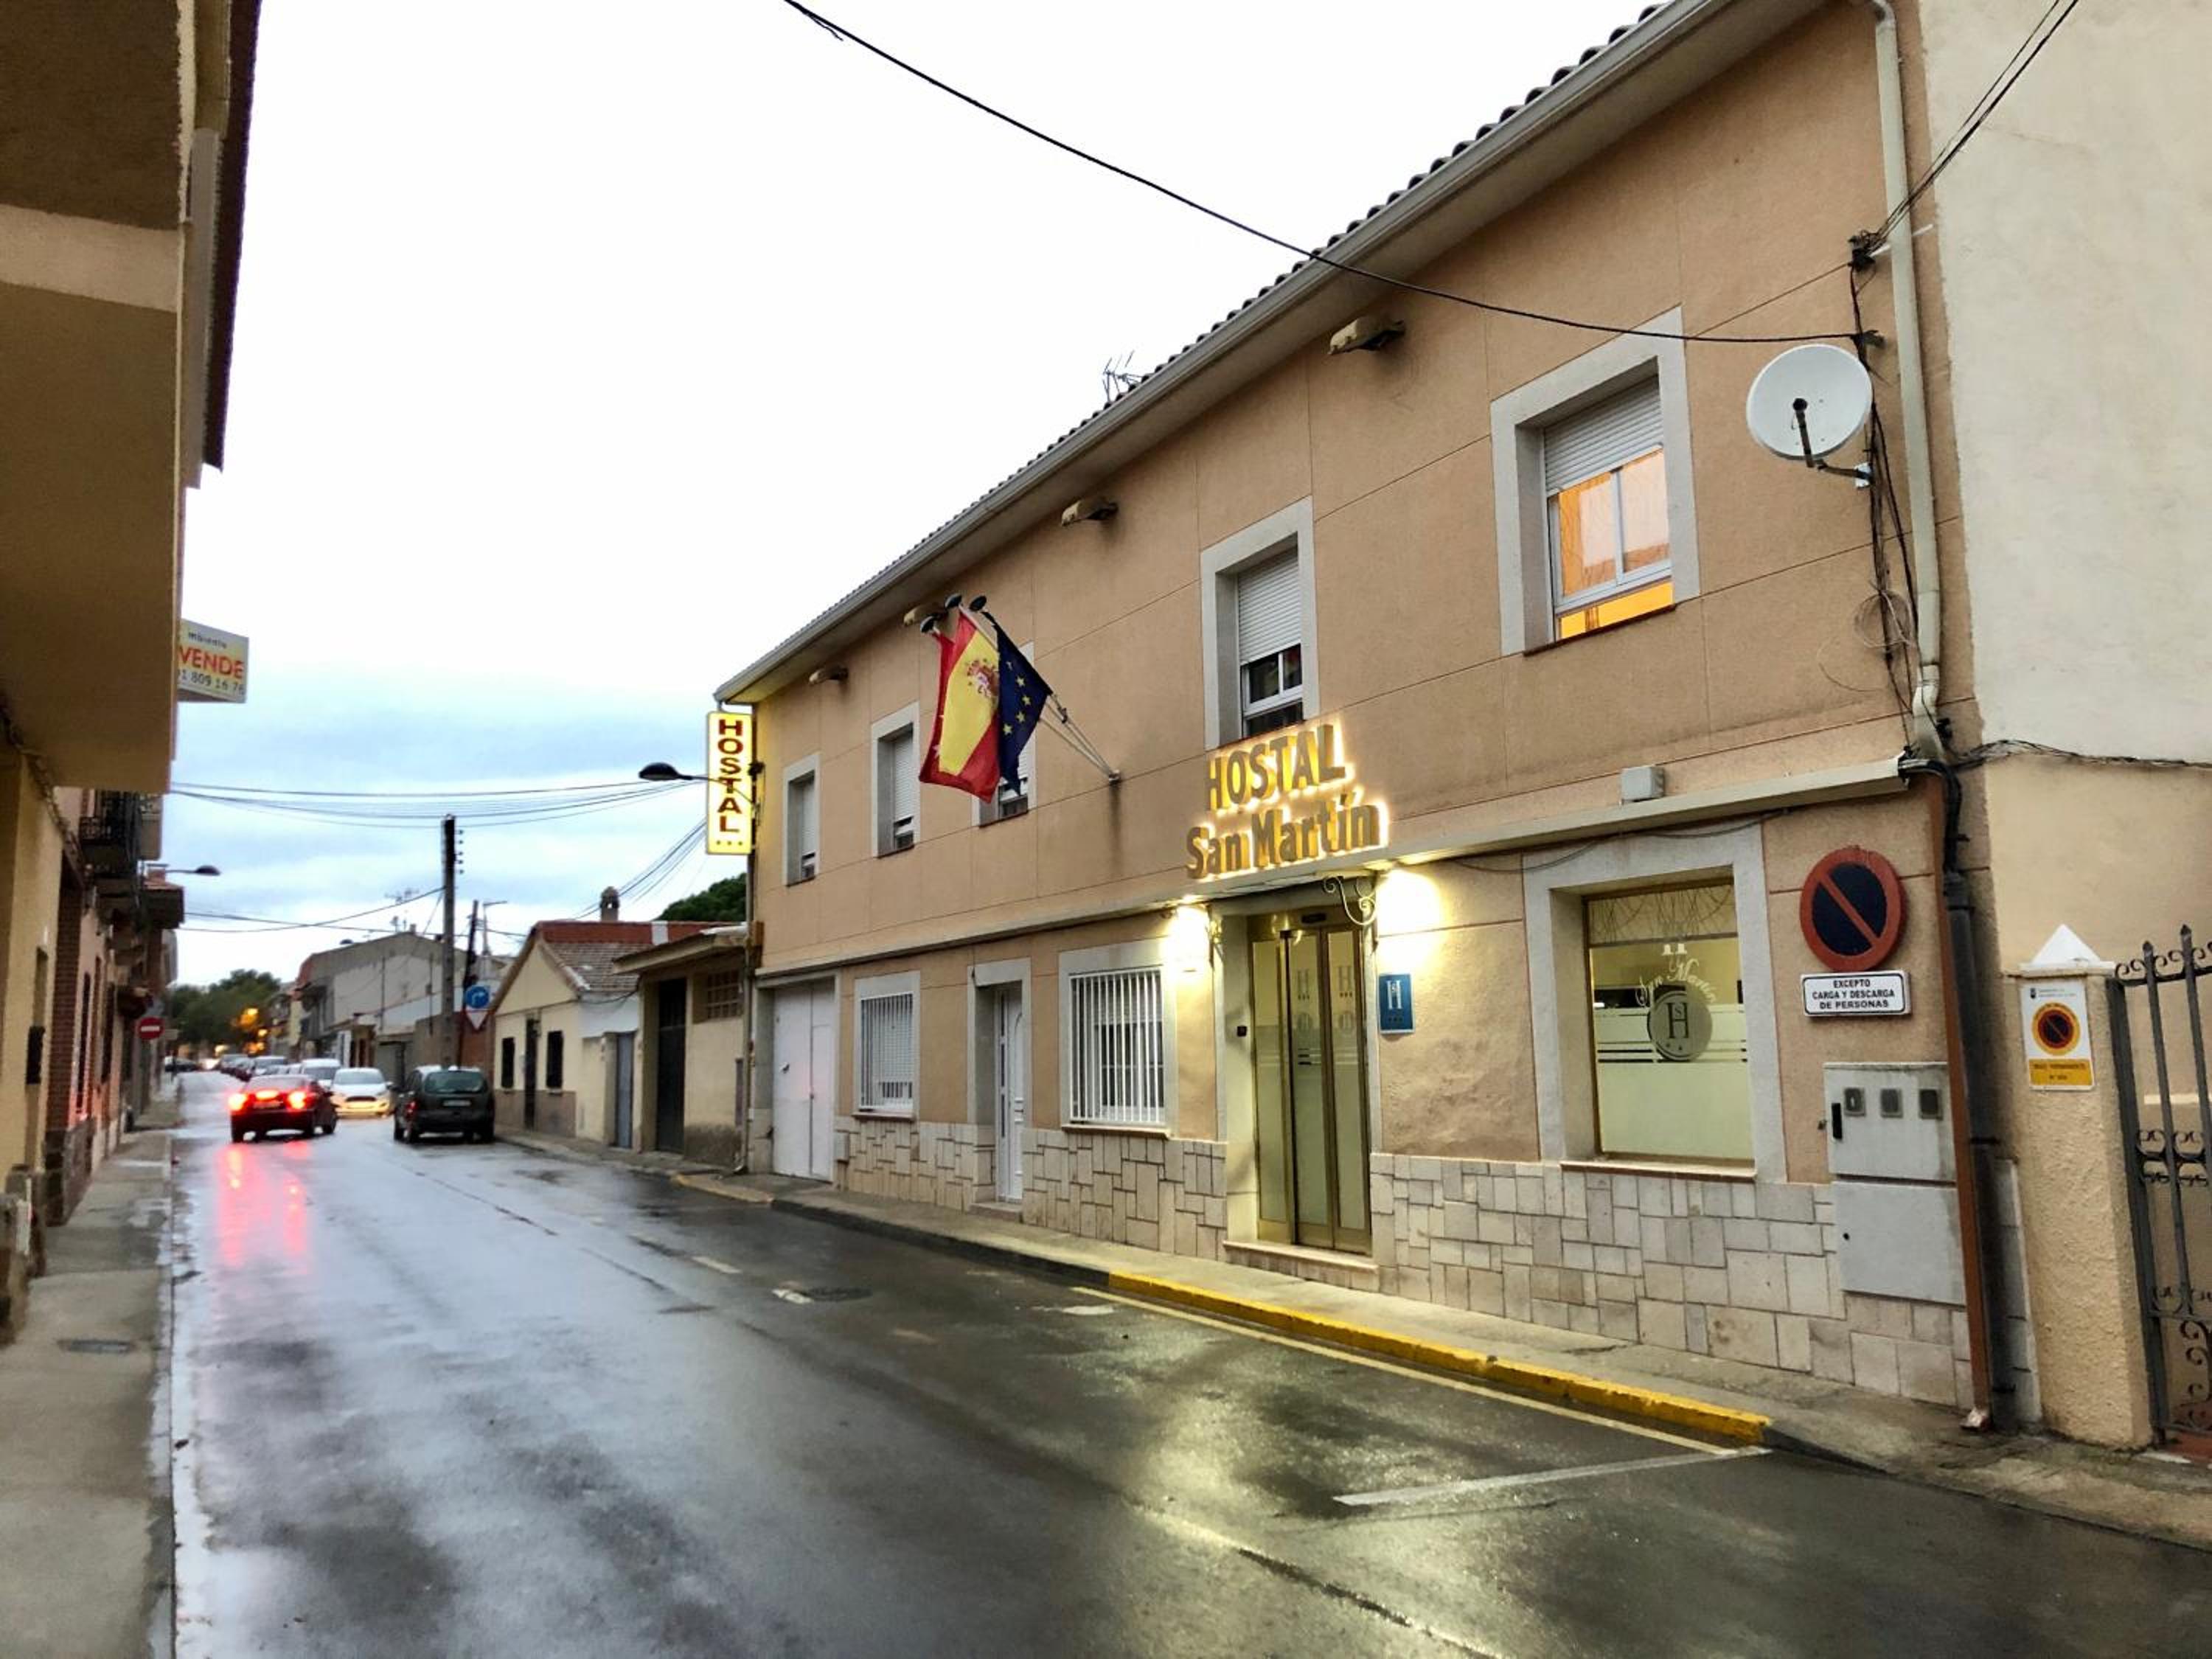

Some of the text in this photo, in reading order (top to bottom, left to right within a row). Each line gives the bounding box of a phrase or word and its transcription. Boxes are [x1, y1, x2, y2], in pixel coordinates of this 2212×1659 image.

[178, 644, 244, 679] VENDE
[717, 719, 744, 832] HOSTAL
[1205, 723, 1346, 811] HOSTAL
[1186, 790, 1380, 879] San Martín
[1812, 991, 1840, 1000] CARGA
[1850, 989, 1895, 998] DESCARGA
[1833, 978, 1871, 988] EXCEPTO
[1819, 999, 1889, 1009] DE PERSONAS
